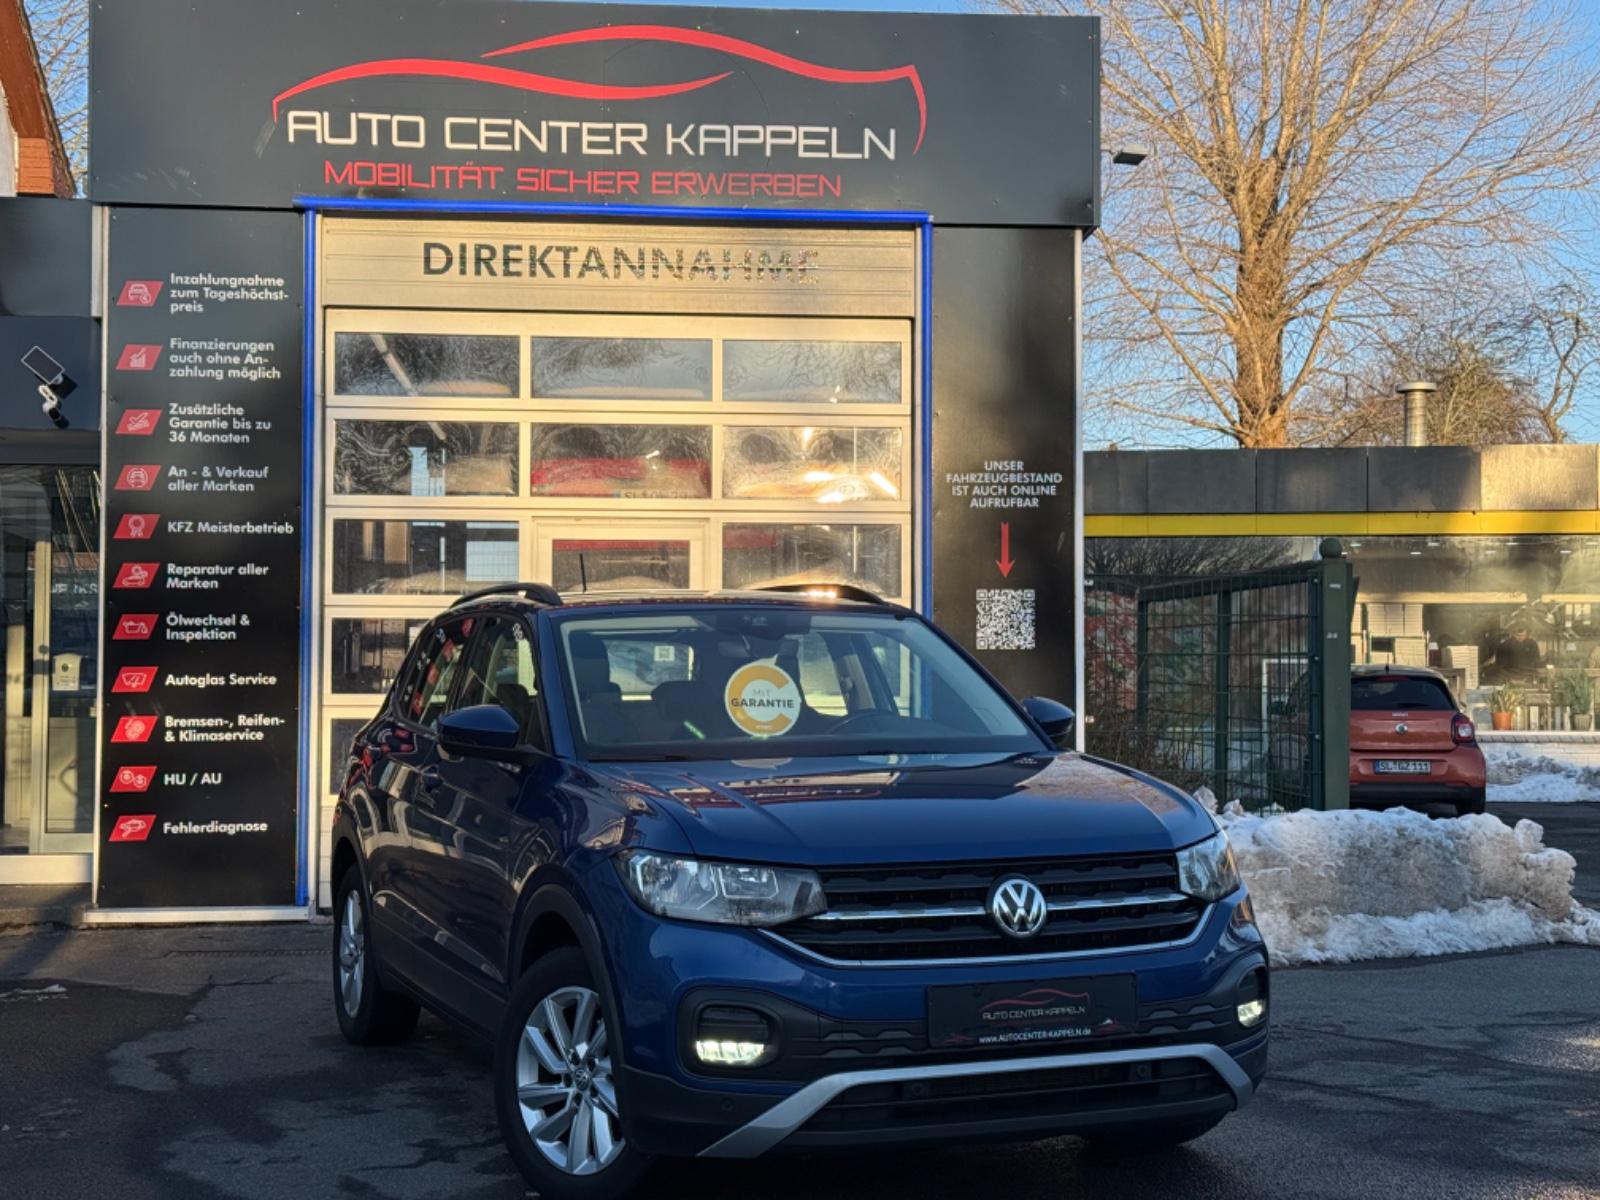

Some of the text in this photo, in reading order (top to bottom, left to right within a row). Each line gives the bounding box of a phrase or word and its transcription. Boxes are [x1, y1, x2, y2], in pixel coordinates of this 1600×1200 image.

[287, 110, 896, 160] AUTO CENTER KAPPELN
[324, 160, 842, 198] MOBILITÄT SICHER ERWERBEN
[170, 273, 284, 287] Inzahlungnahme
[170, 287, 289, 301] zum Tageshöchst-
[170, 300, 204, 314] preis
[170, 338, 274, 353] Finanzierungen
[169, 353, 268, 364] auch ohne An-
[169, 367, 281, 381] zahlung möglich
[169, 403, 244, 416] Zusätzliche
[169, 417, 271, 429] Garantie bis zu
[169, 431, 250, 444] 36 Monaten
[202, 467, 211, 477] &
[216, 466, 269, 479] Verkauf
[984, 461, 1024, 471] UNSER
[946, 473, 1062, 483] FAHRZEUGBESTAND
[168, 480, 254, 492] aller Marken
[952, 485, 1056, 496] IST AUCH ONLINE
[970, 498, 1039, 508] AUFRUFBAR
[168, 522, 294, 534] KFZ Meisterbetrieb
[167, 563, 269, 576] Reparatur aller
[167, 578, 219, 589] Marken
[166, 611, 250, 626] Ölwechsel &
[166, 628, 236, 642] Inspektion
[165, 674, 277, 688] Autoglas Service
[731, 698, 794, 708] GARANTIE
[165, 714, 285, 728] Bremsen-, Reifen-
[164, 729, 264, 742] & Klimaservice
[164, 774, 186, 785] HU
[201, 773, 222, 784] AU
[163, 821, 268, 835] Fehlerdiagnose
[982, 1011, 1008, 1020] AUTO
